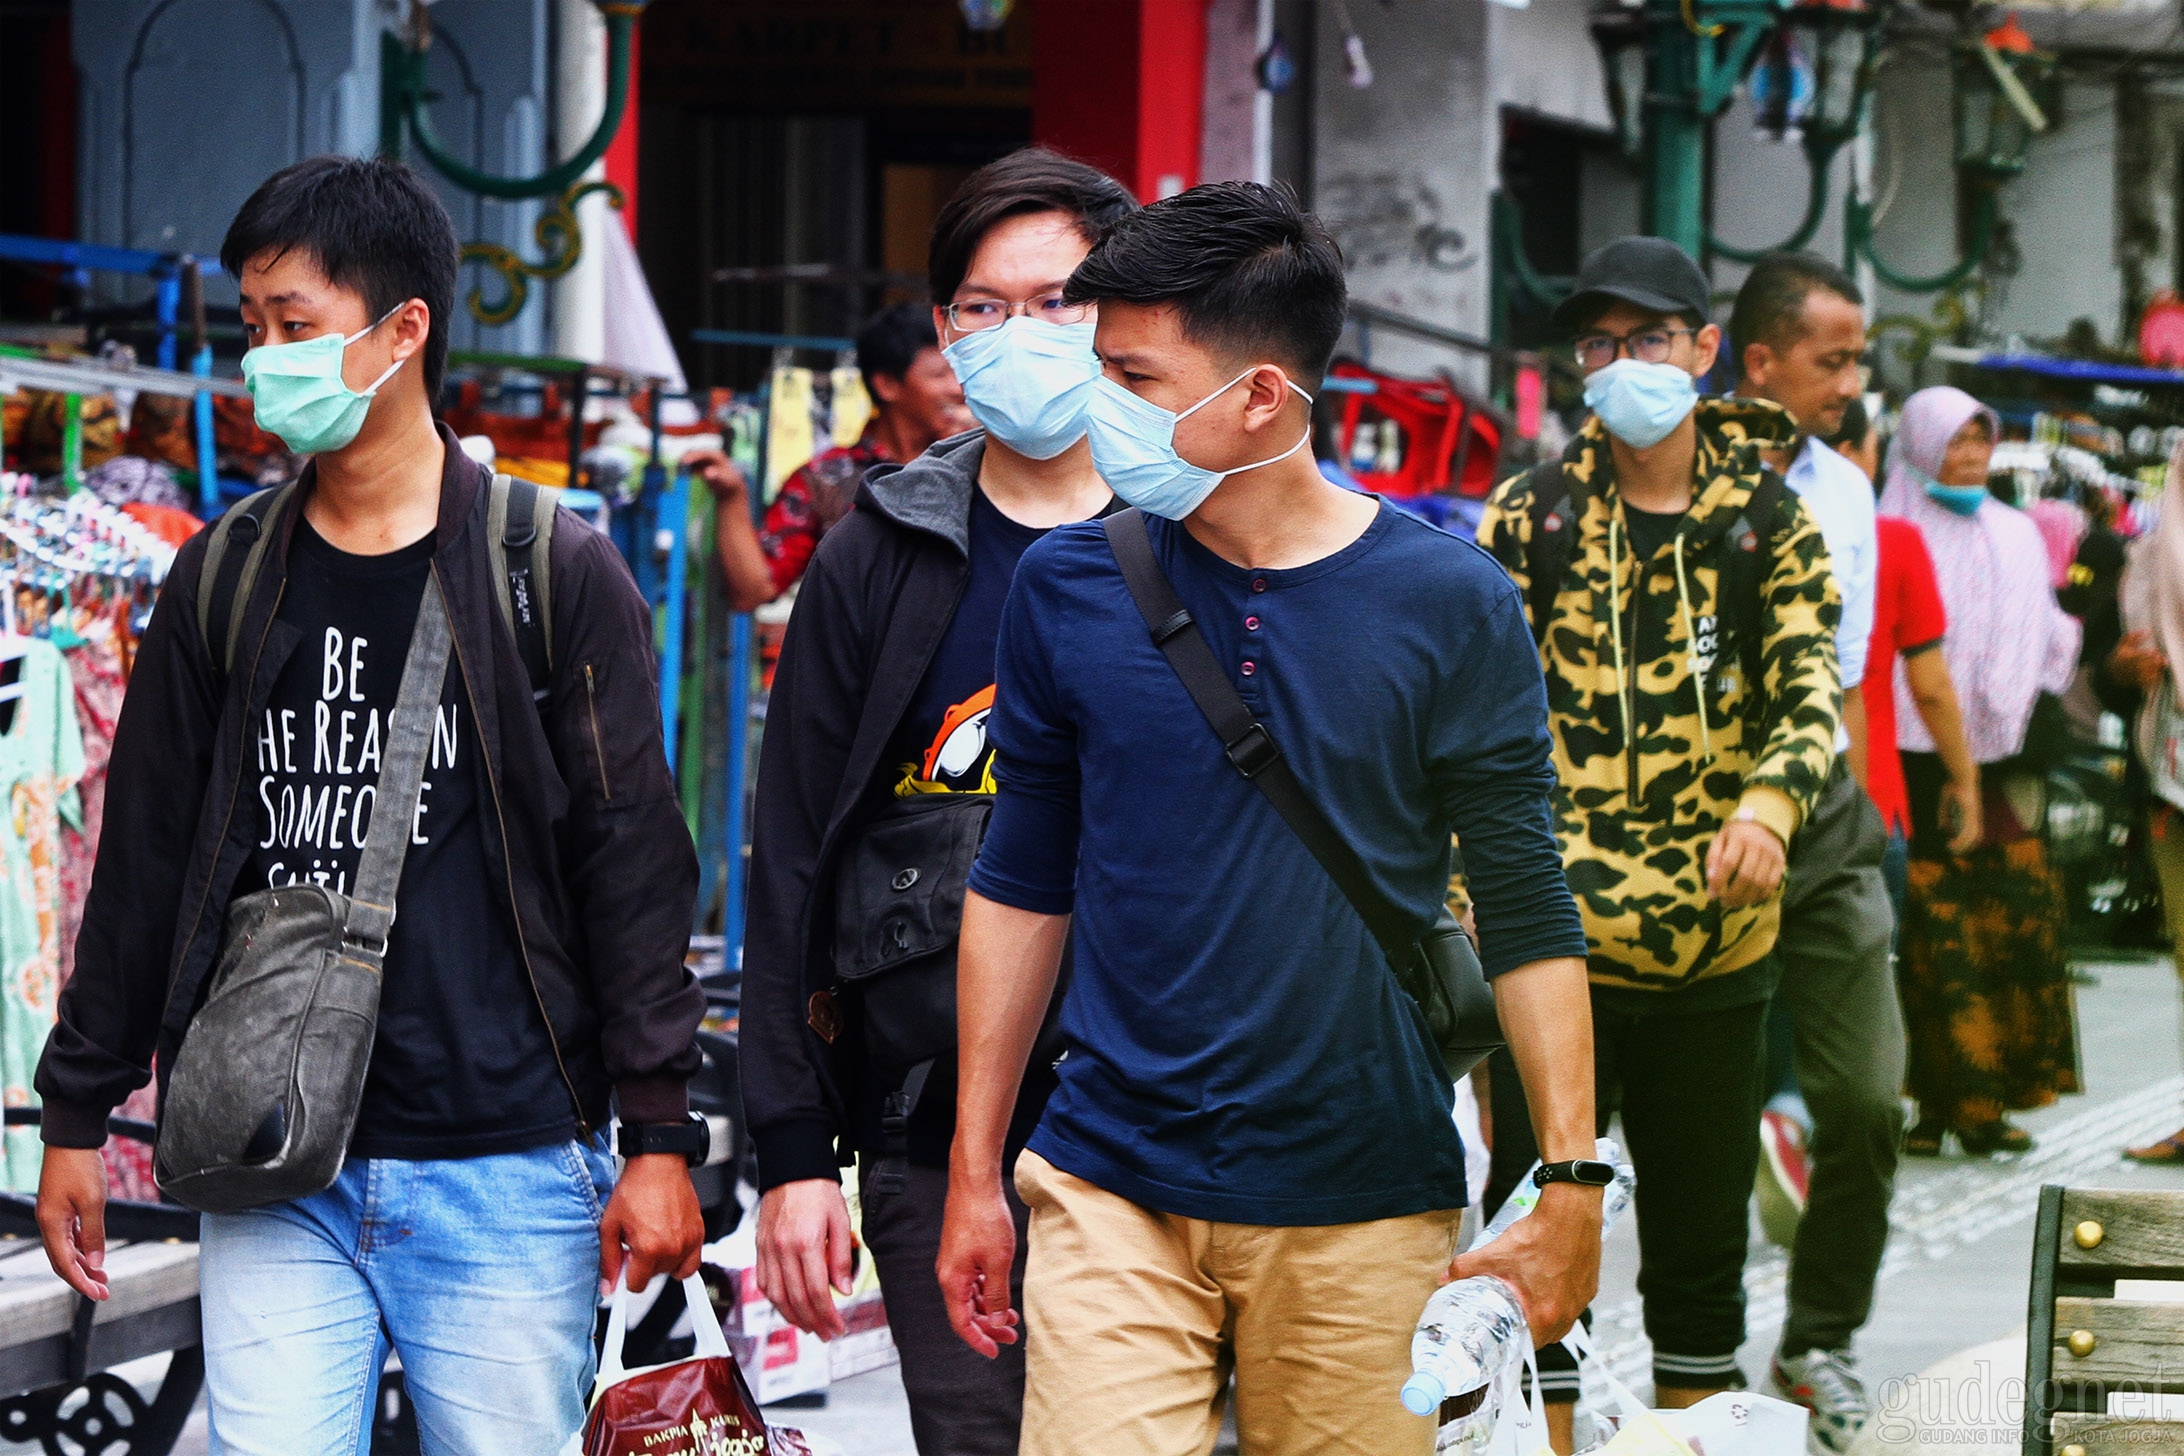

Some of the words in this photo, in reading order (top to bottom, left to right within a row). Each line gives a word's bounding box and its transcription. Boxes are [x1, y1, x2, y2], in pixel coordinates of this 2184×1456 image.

[322, 626, 368, 702] BE
[257, 708, 298, 773] HE
[313, 700, 458, 774] REAN
[259, 775, 432, 849] SOMEOE
[643, 1425, 689, 1448] BAKPIA
